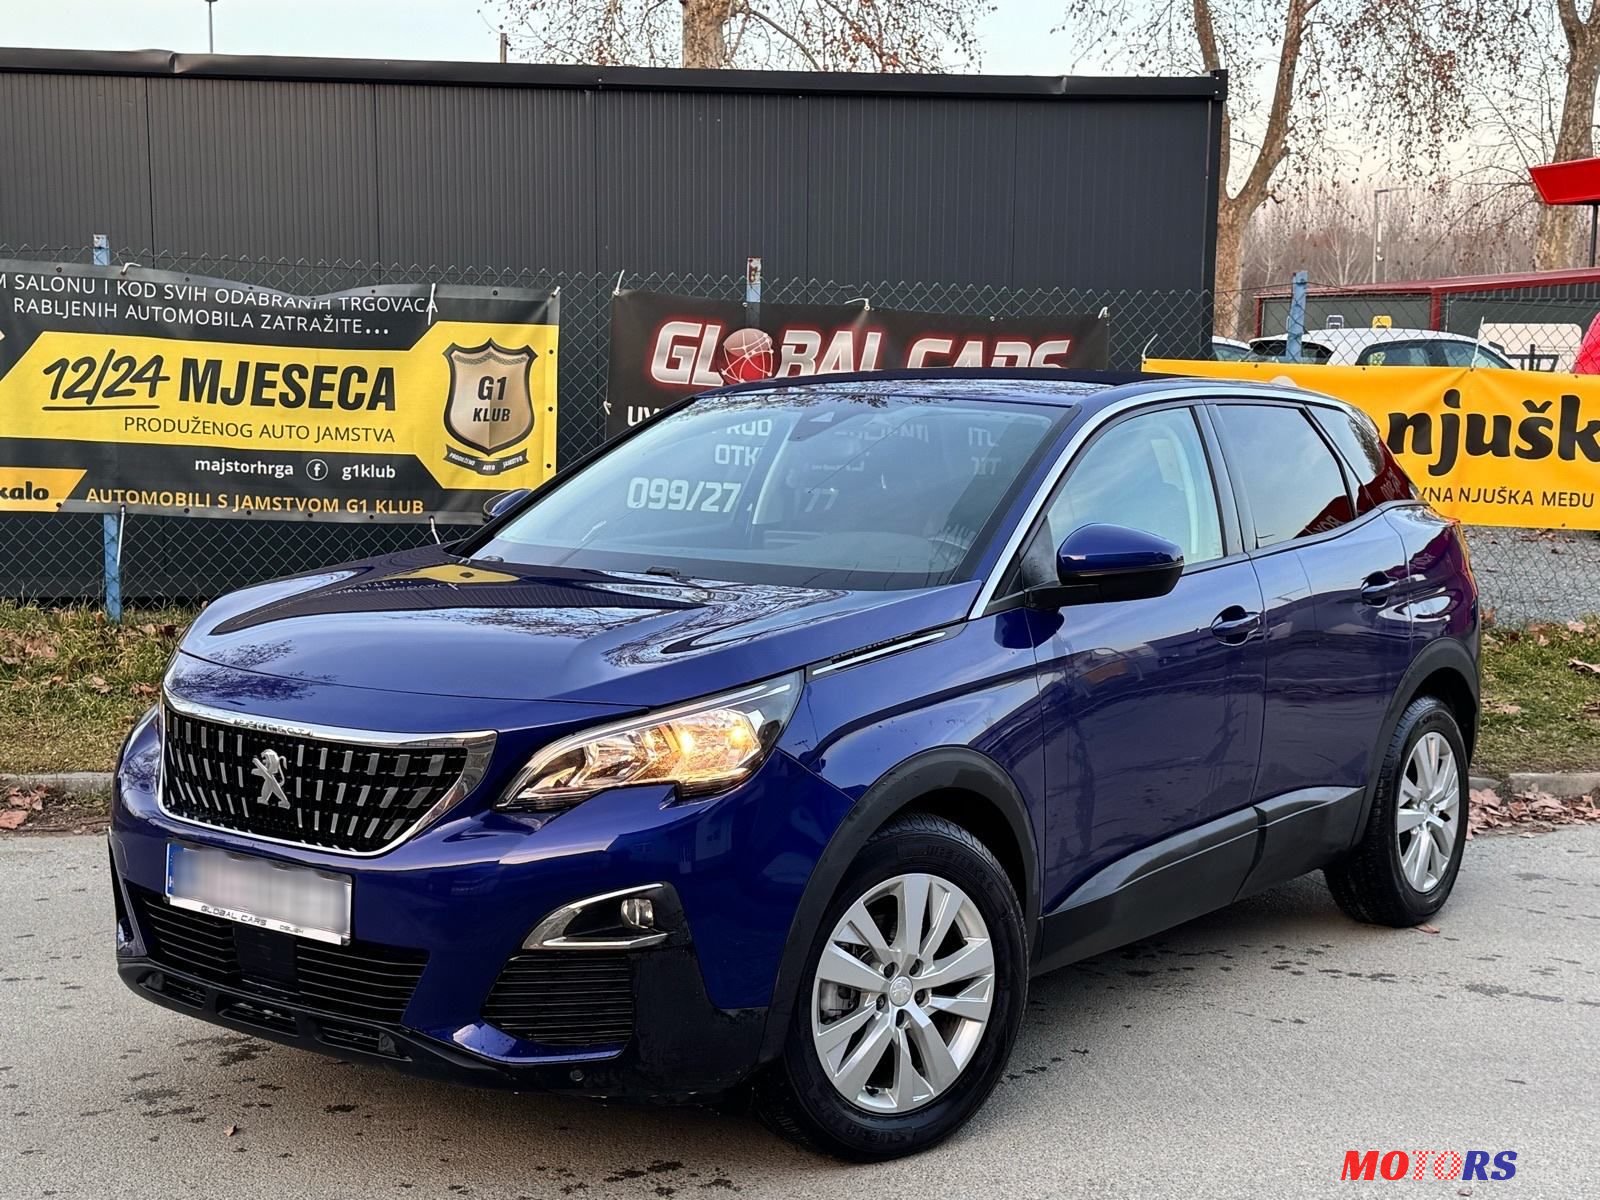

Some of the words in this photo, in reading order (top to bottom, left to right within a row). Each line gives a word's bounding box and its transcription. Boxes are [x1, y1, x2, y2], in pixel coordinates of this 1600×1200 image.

[14, 274, 96, 294] SALONU
[117, 280, 156, 298] KOD
[164, 284, 207, 302] SVIH
[215, 288, 330, 310] ODABRANIH
[339, 297, 440, 313] TRGOVACA
[14, 298, 117, 319] RABLJENIH
[125, 304, 254, 329] AUTOMOBILA
[43, 348, 170, 405] 12/24
[179, 357, 396, 411] MJESECA
[477, 376, 507, 401] G1
[472, 407, 511, 423] KLUB
[124, 416, 253, 438] PRODUŽENOG
[259, 423, 310, 440] AUTO
[315, 425, 395, 443] JAMSTVA
[714, 444, 764, 467] OTK
[195, 458, 294, 479] majstorhrga
[341, 463, 396, 480] g1klub
[86, 487, 211, 508] AUTOMOBILI
[217, 493, 228, 508] S
[233, 494, 339, 513] JAMSTVOM
[346, 498, 368, 514] G1
[375, 499, 424, 515] KLUB
[1458, 485, 1534, 506] NJUŠKA
[1541, 490, 1595, 509] MEĐU
[200, 904, 238, 920] GLOBAL
[240, 913, 268, 927] CARS
